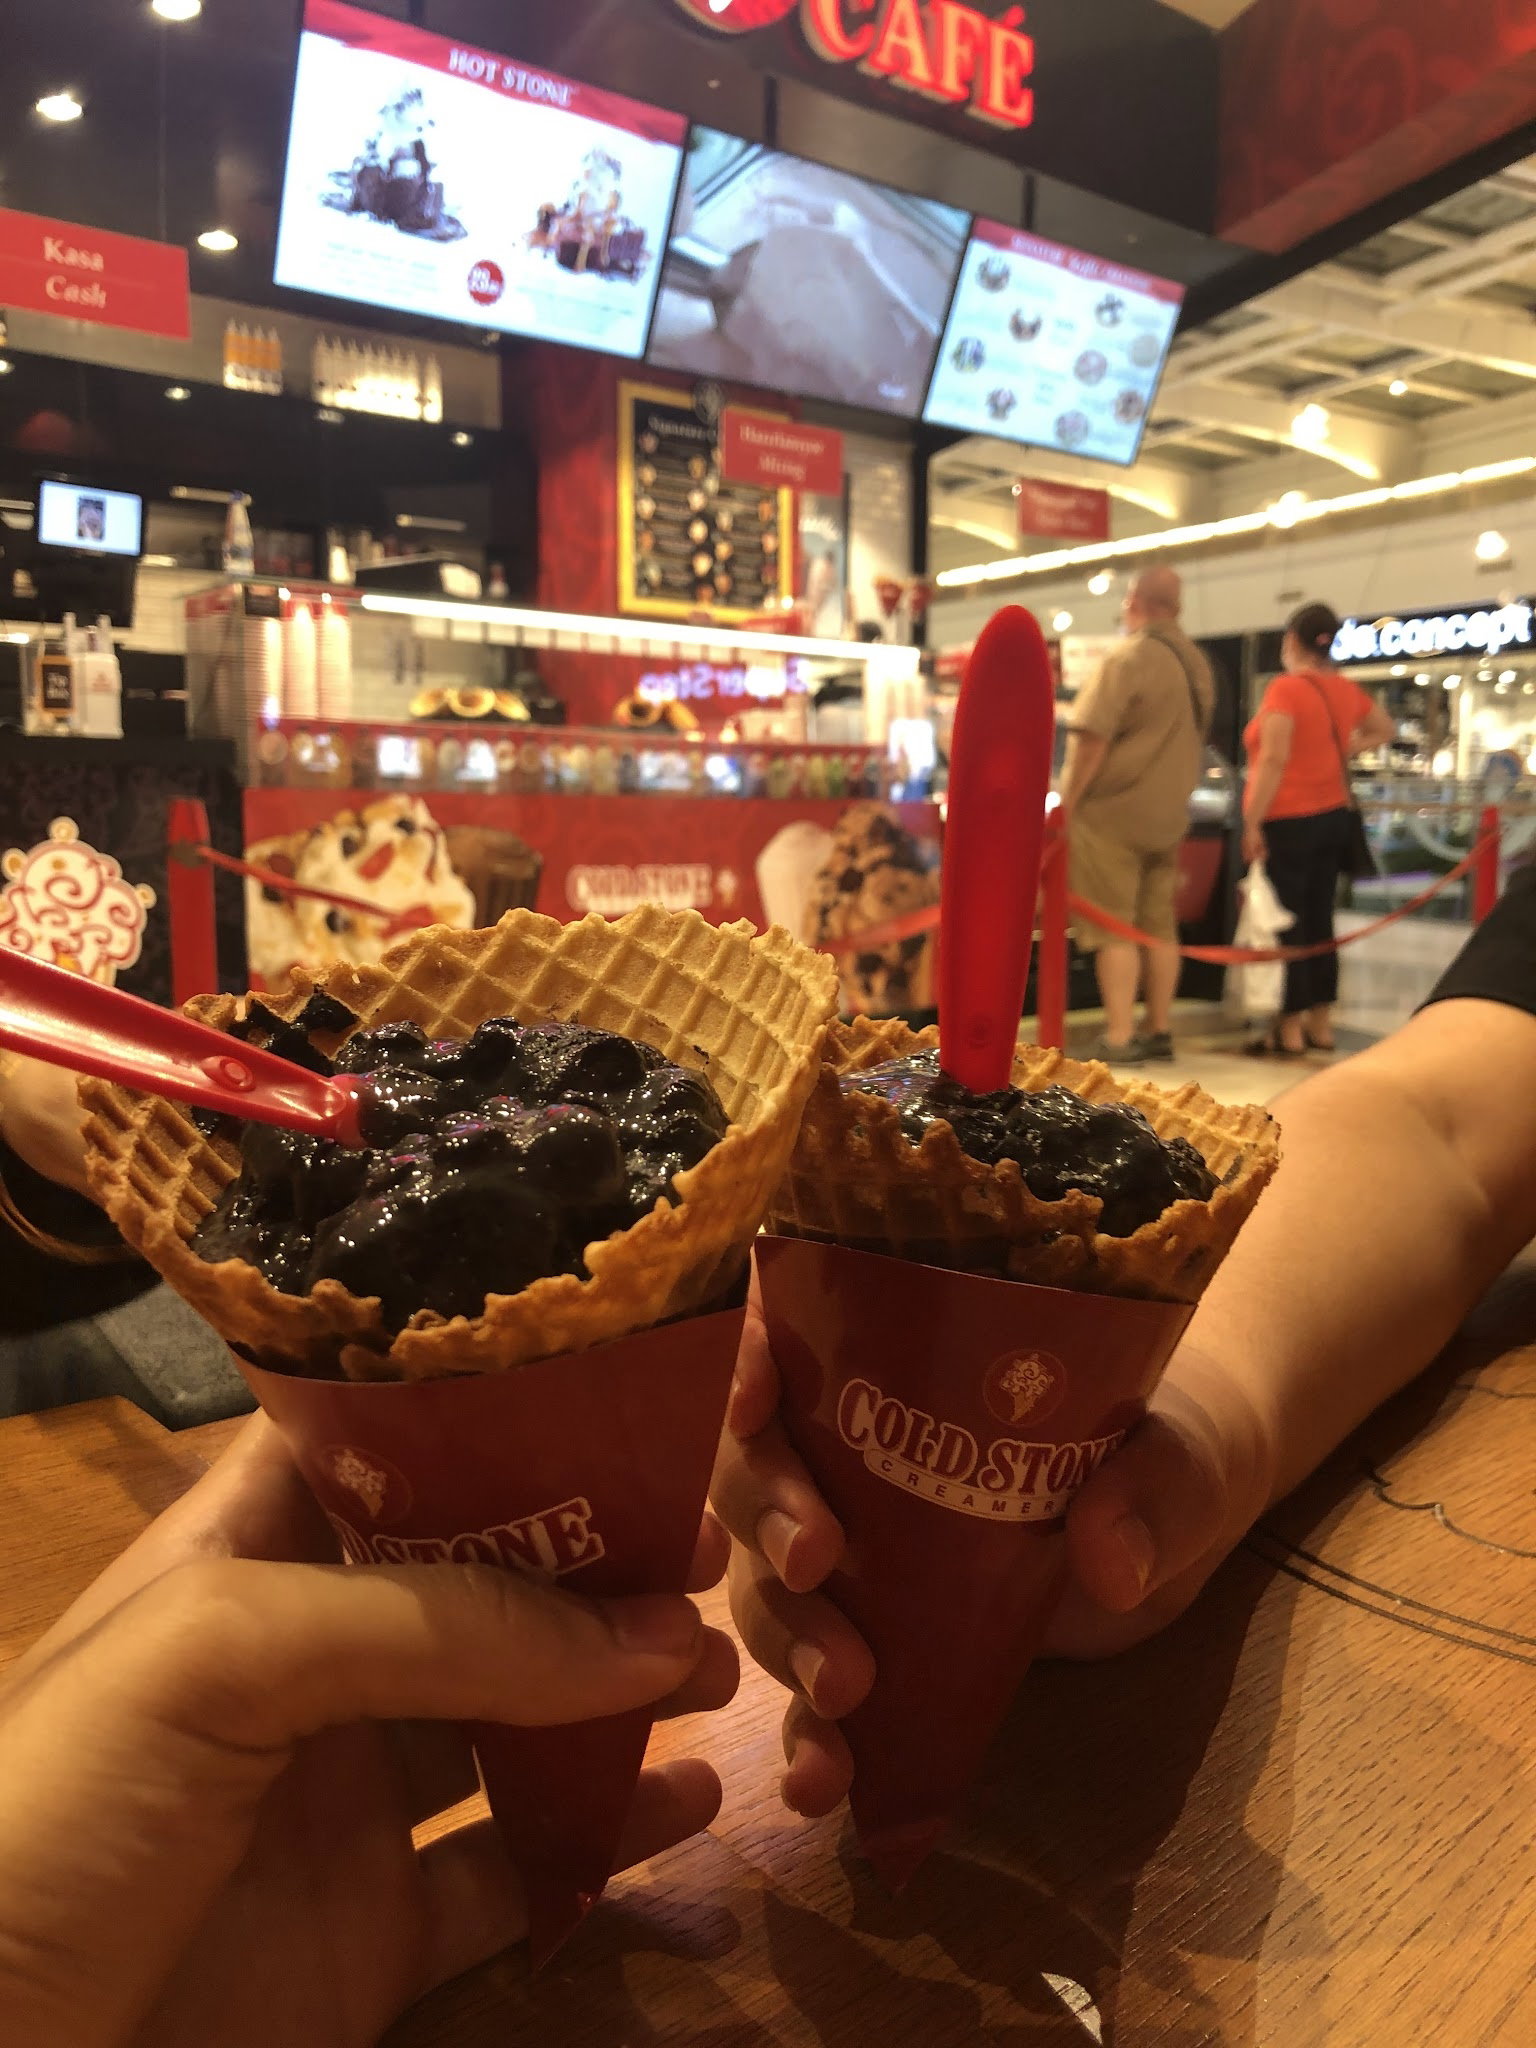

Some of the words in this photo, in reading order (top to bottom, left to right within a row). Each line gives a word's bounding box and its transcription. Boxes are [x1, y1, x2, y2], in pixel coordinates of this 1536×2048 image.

[448, 48, 498, 83] HOT
[801, 0, 1035, 129] CAFÉ
[43, 236, 105, 273] Kasa
[45, 275, 107, 309] Cash
[837, 1377, 979, 1484] COLD
